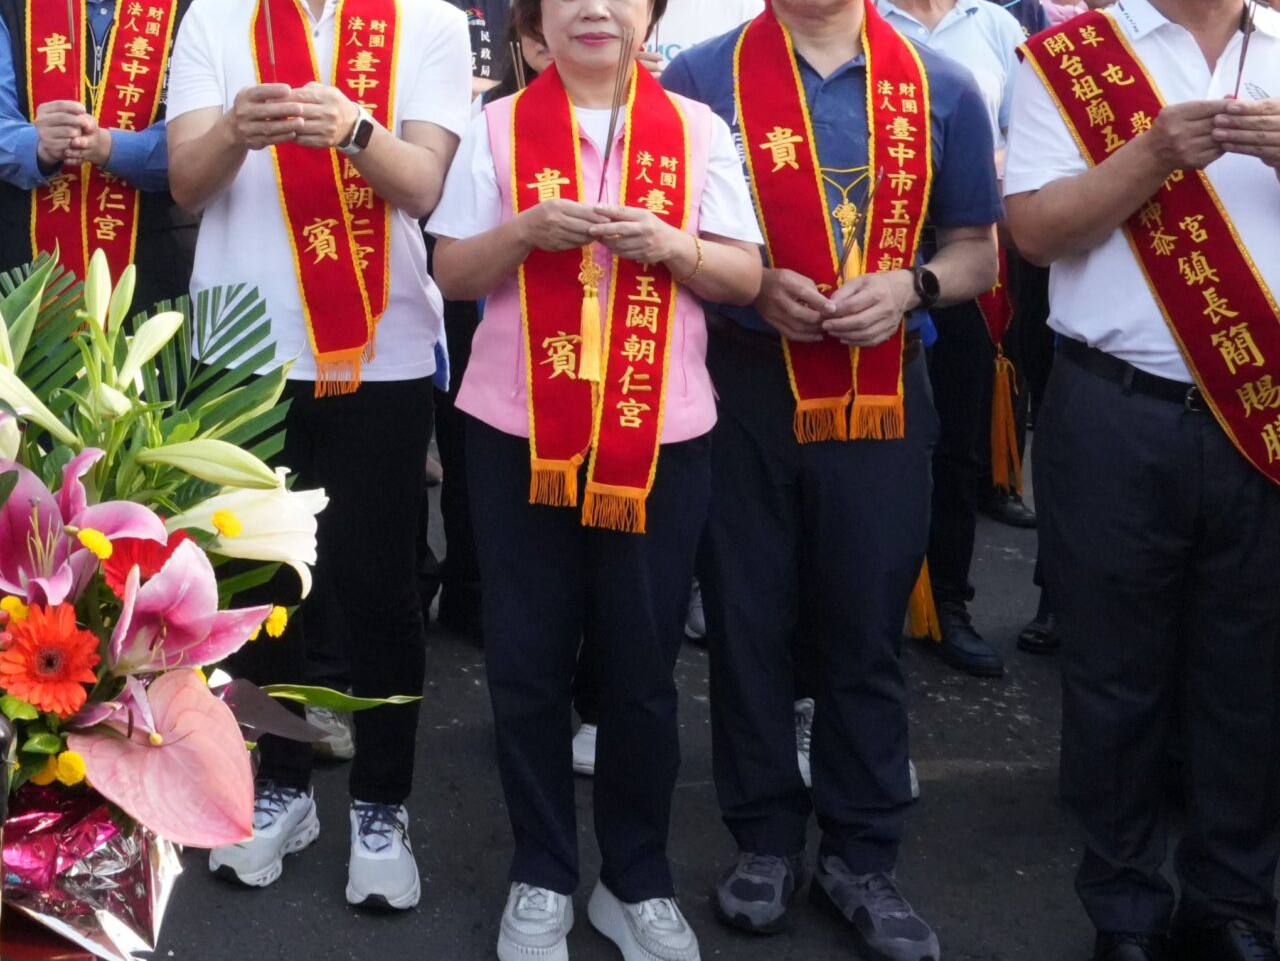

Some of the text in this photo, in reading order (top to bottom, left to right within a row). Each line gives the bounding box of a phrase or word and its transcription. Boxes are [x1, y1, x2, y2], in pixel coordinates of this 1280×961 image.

[124, 2, 144, 32] 法人
[145, 6, 165, 37] 財團
[345, 16, 365, 47] 法人
[369, 20, 387, 48] 財團
[481, 30, 491, 77] 民政局
[877, 80, 896, 112] 法人
[899, 83, 918, 114] 財團
[37, 33, 77, 213] 貴賓
[93, 36, 154, 241] 臺中市玉仁宮
[1043, 32, 1178, 255] 開台祖廟五神爺
[636, 151, 654, 183] 法人
[660, 156, 678, 188] 財團
[616, 188, 673, 428] 臺玉闕朝仁宮
